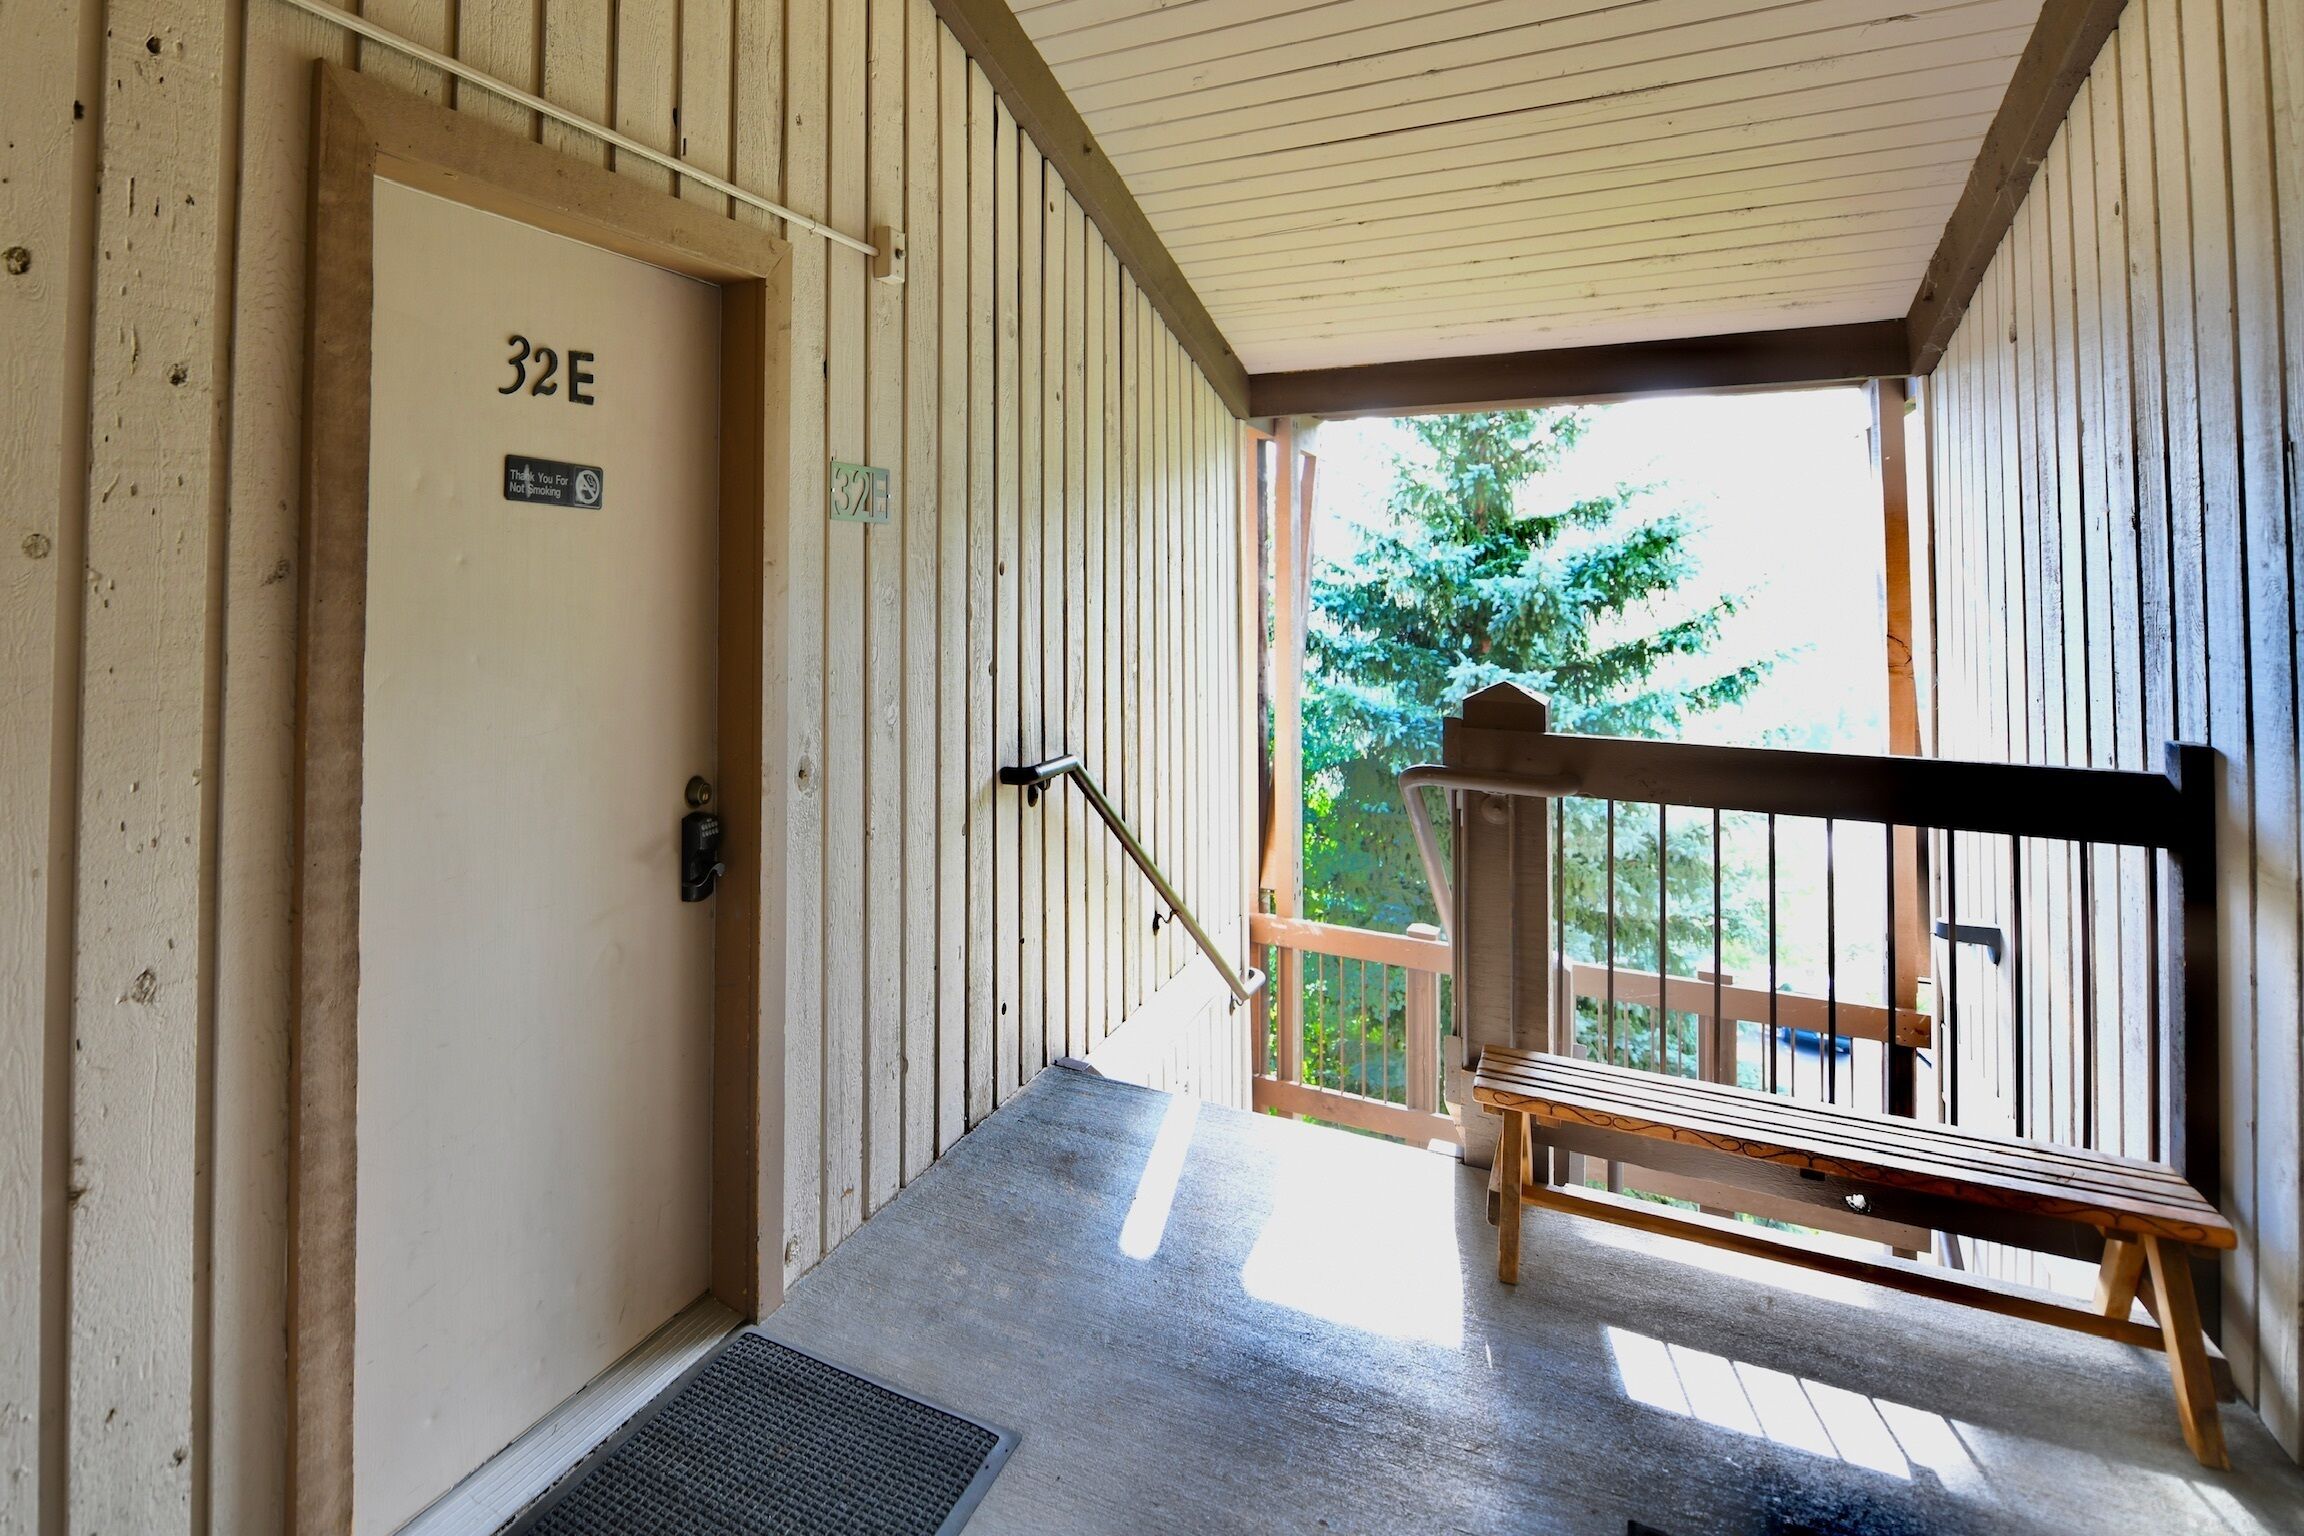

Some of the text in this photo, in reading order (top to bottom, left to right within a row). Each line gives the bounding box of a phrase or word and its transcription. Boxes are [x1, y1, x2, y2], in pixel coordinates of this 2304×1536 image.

[498, 335, 594, 406] 32E
[510, 482, 561, 499] Not Smoking
[538, 472, 553, 484] You
[556, 475, 569, 486] For
[832, 464, 888, 519] 32E
